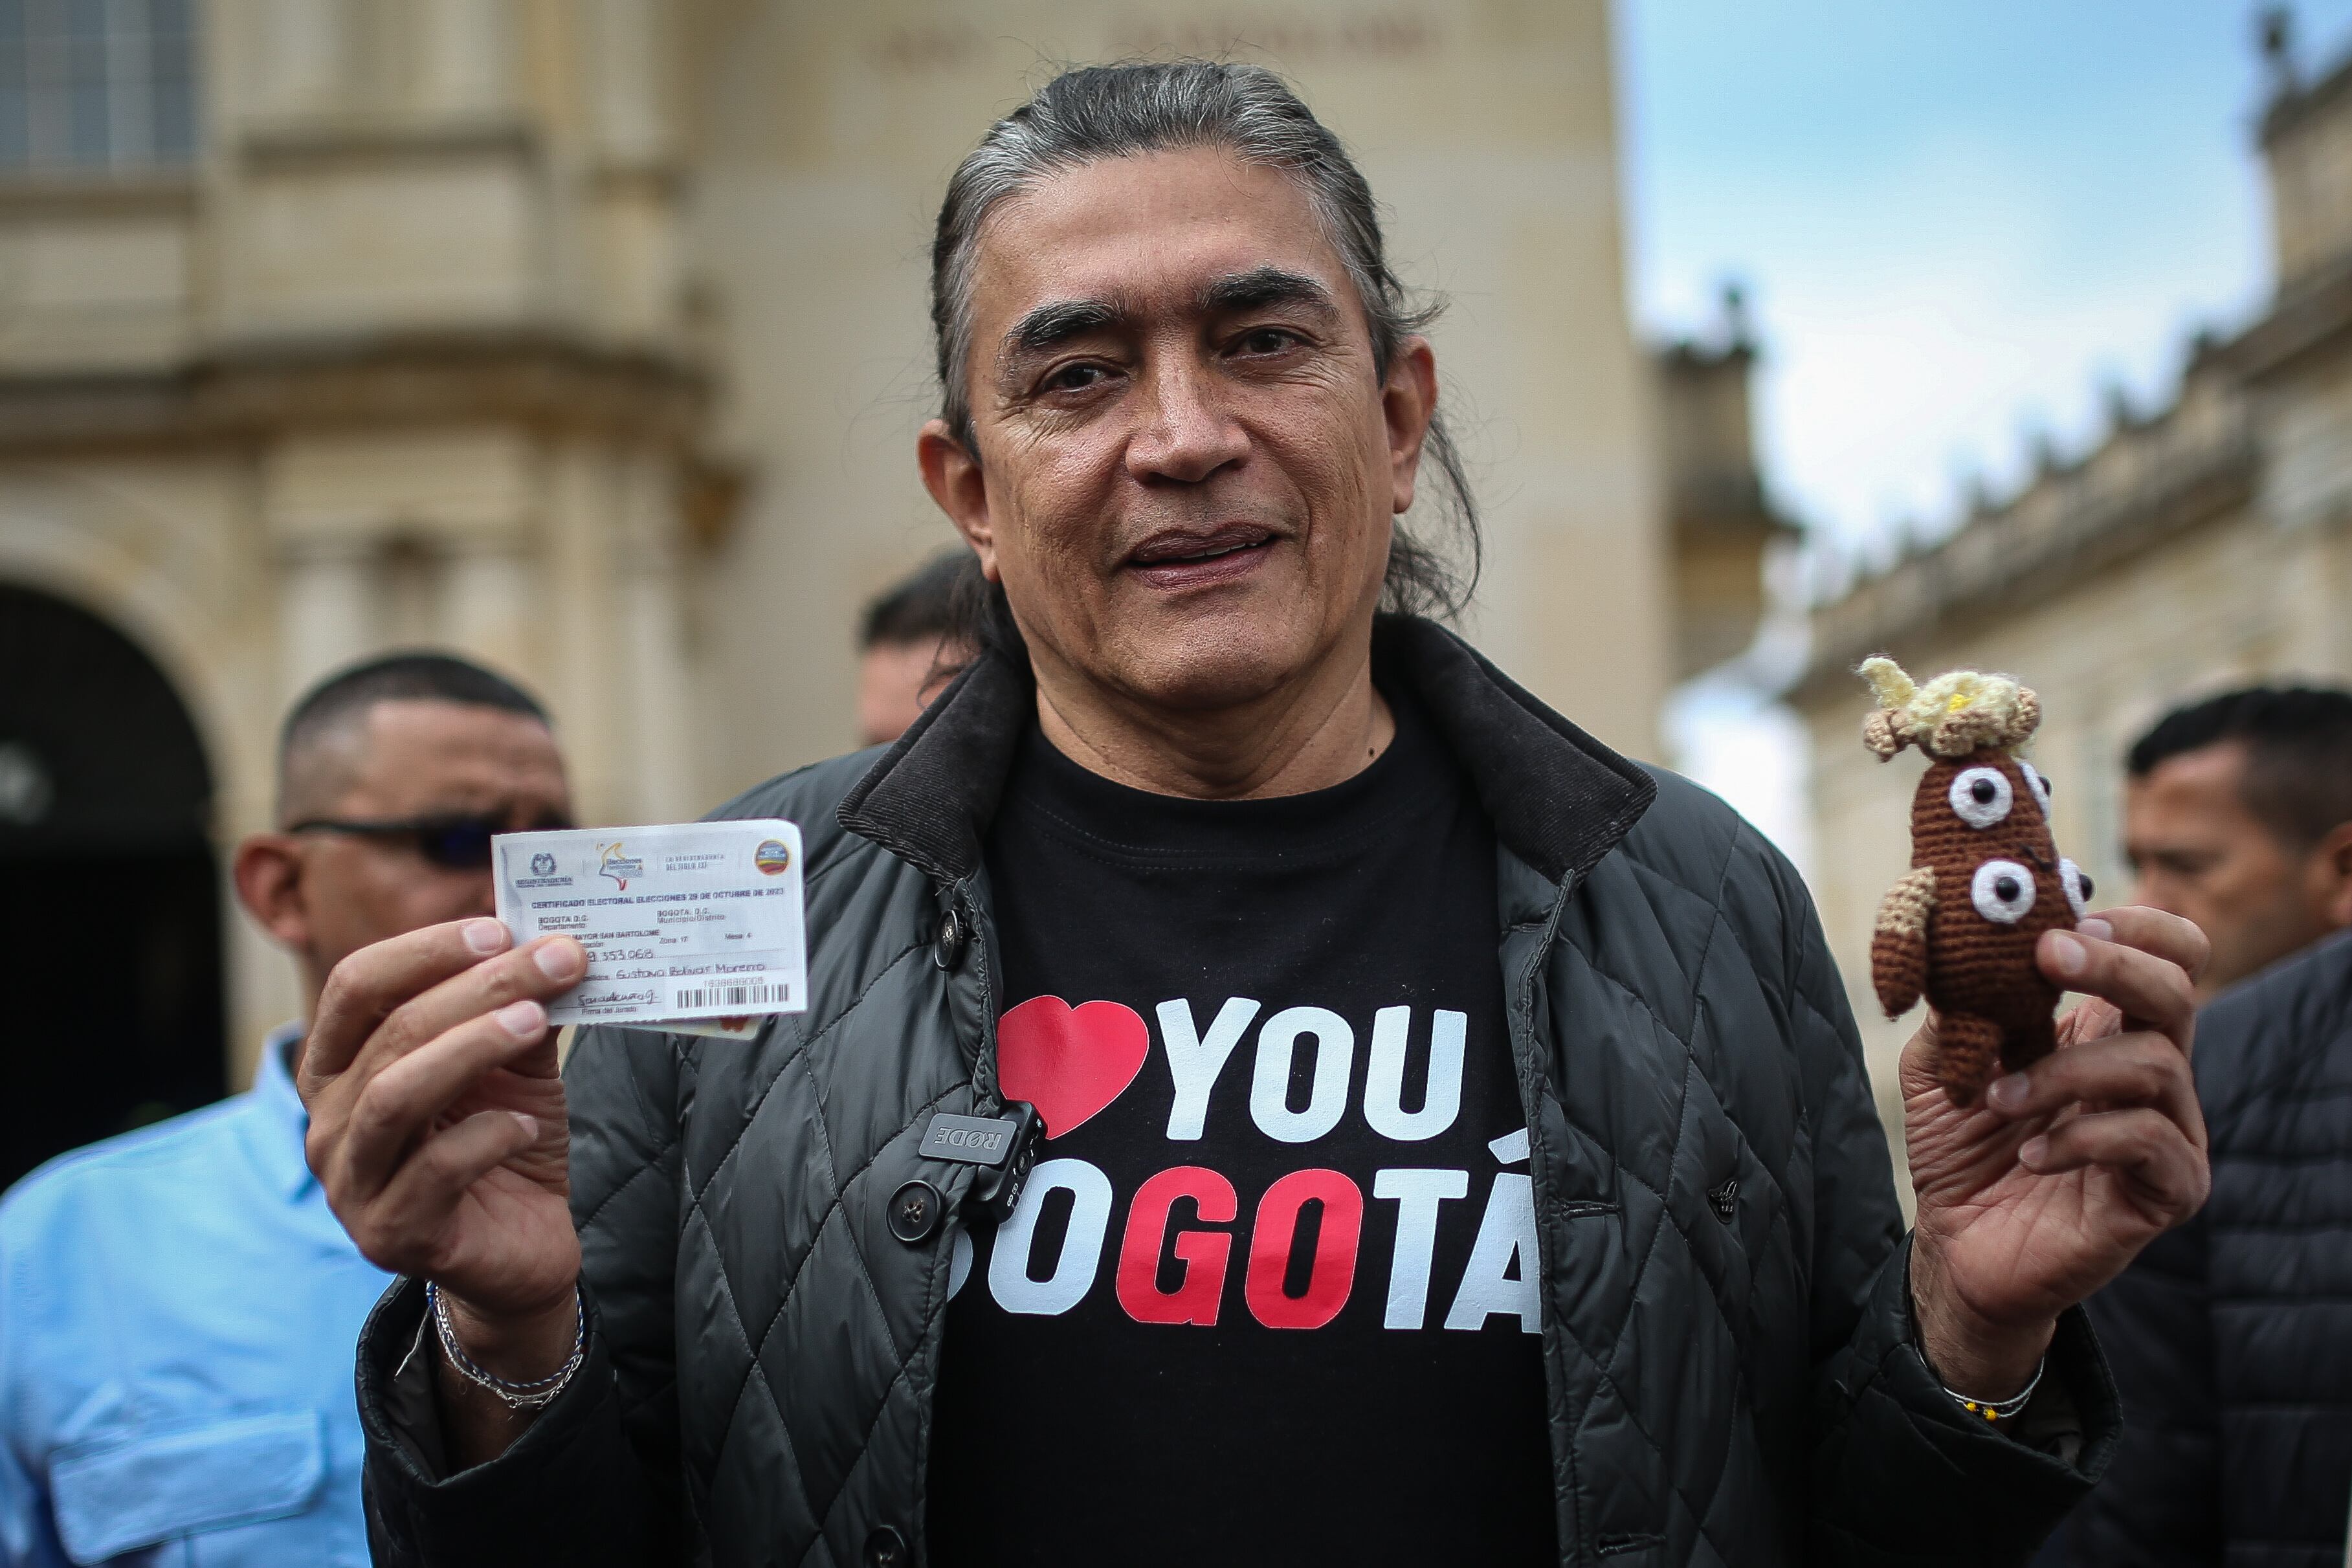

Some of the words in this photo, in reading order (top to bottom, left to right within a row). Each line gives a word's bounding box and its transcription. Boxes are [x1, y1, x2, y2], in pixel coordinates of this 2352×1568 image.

[531, 900, 585, 909] CERTIFICADO
[587, 897, 634, 906] ELECTORAL
[636, 894, 686, 903] ELECCIONES
[713, 890, 751, 899] OCTUBRE
[538, 923, 585, 931] Departamento
[716, 963, 766, 974] Moreno
[1155, 997, 1467, 1143] YOU
[947, 1127, 1543, 1334] OGOTÁ
